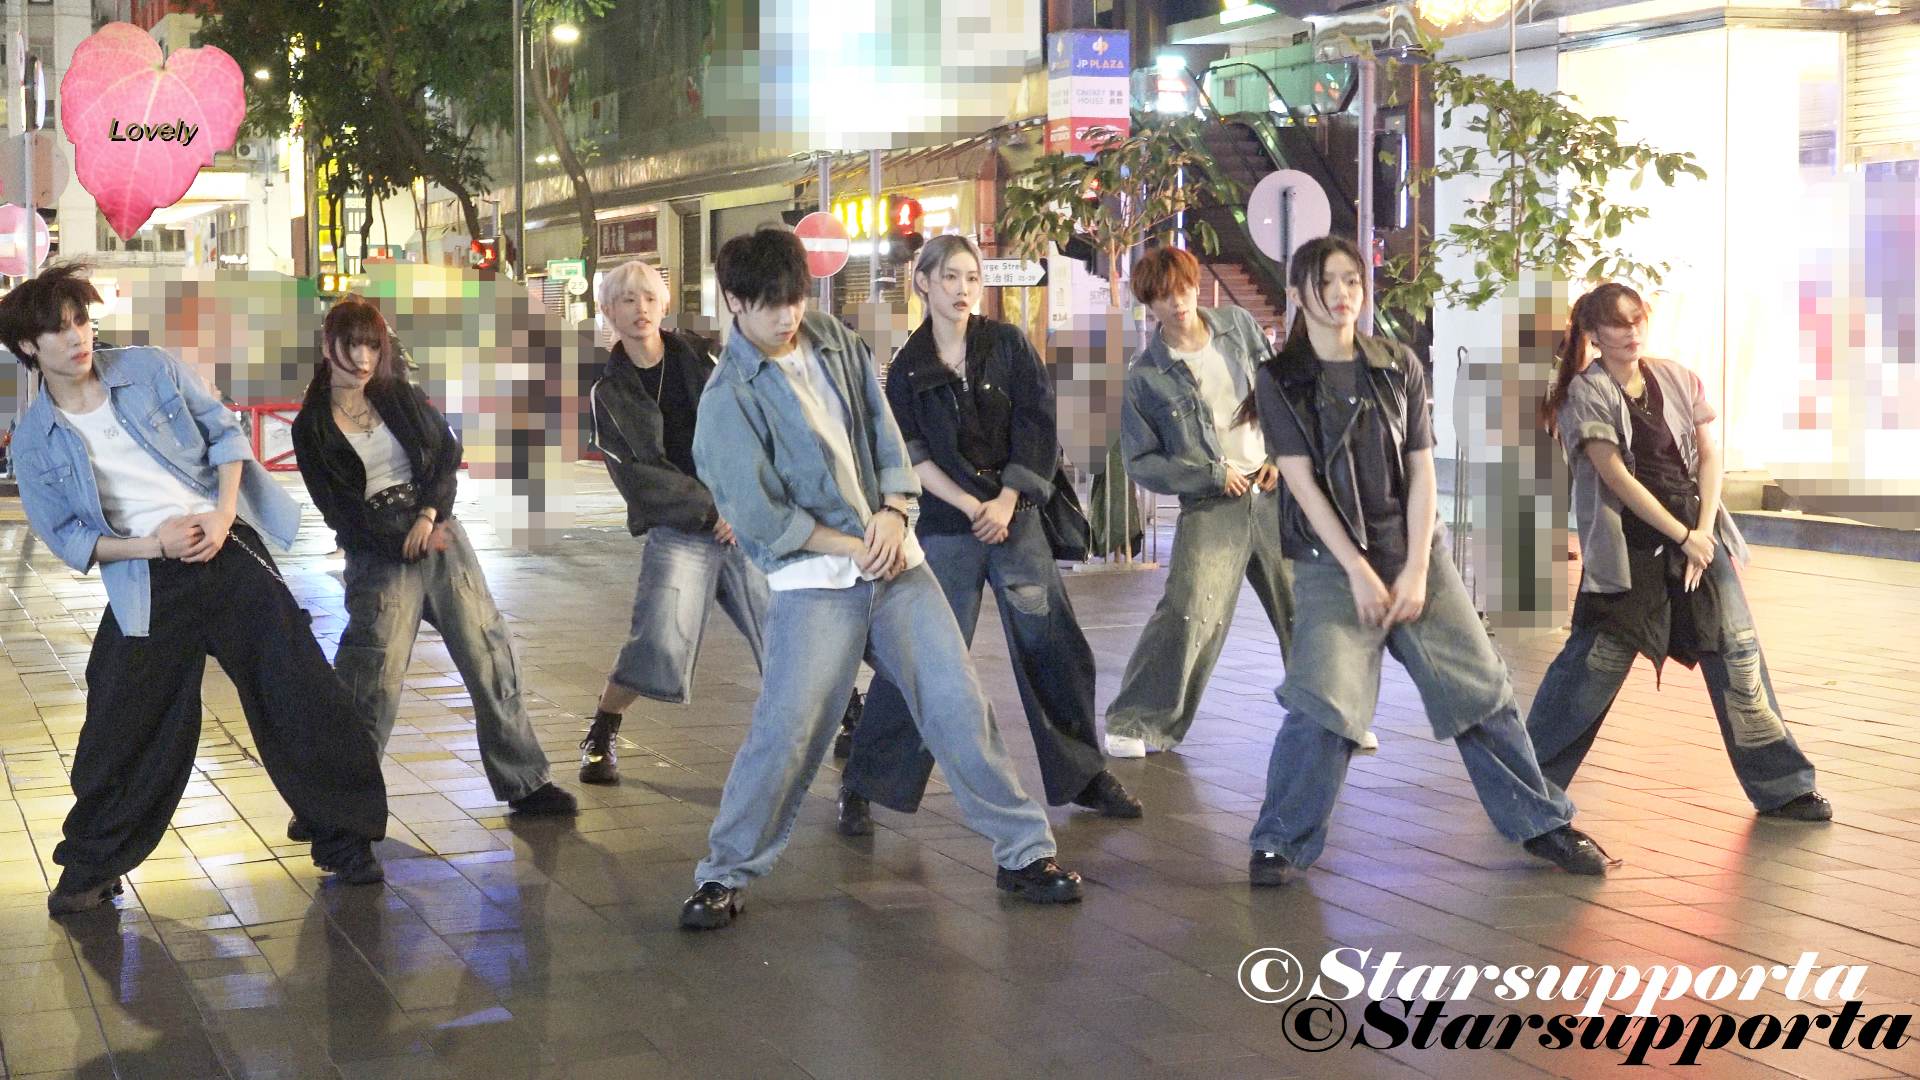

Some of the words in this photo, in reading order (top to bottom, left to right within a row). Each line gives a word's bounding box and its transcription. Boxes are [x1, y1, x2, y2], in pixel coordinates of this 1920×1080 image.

[1076, 59, 1088, 69] JP
[1089, 59, 1125, 69] PLAZA
[983, 263, 999, 272] rge
